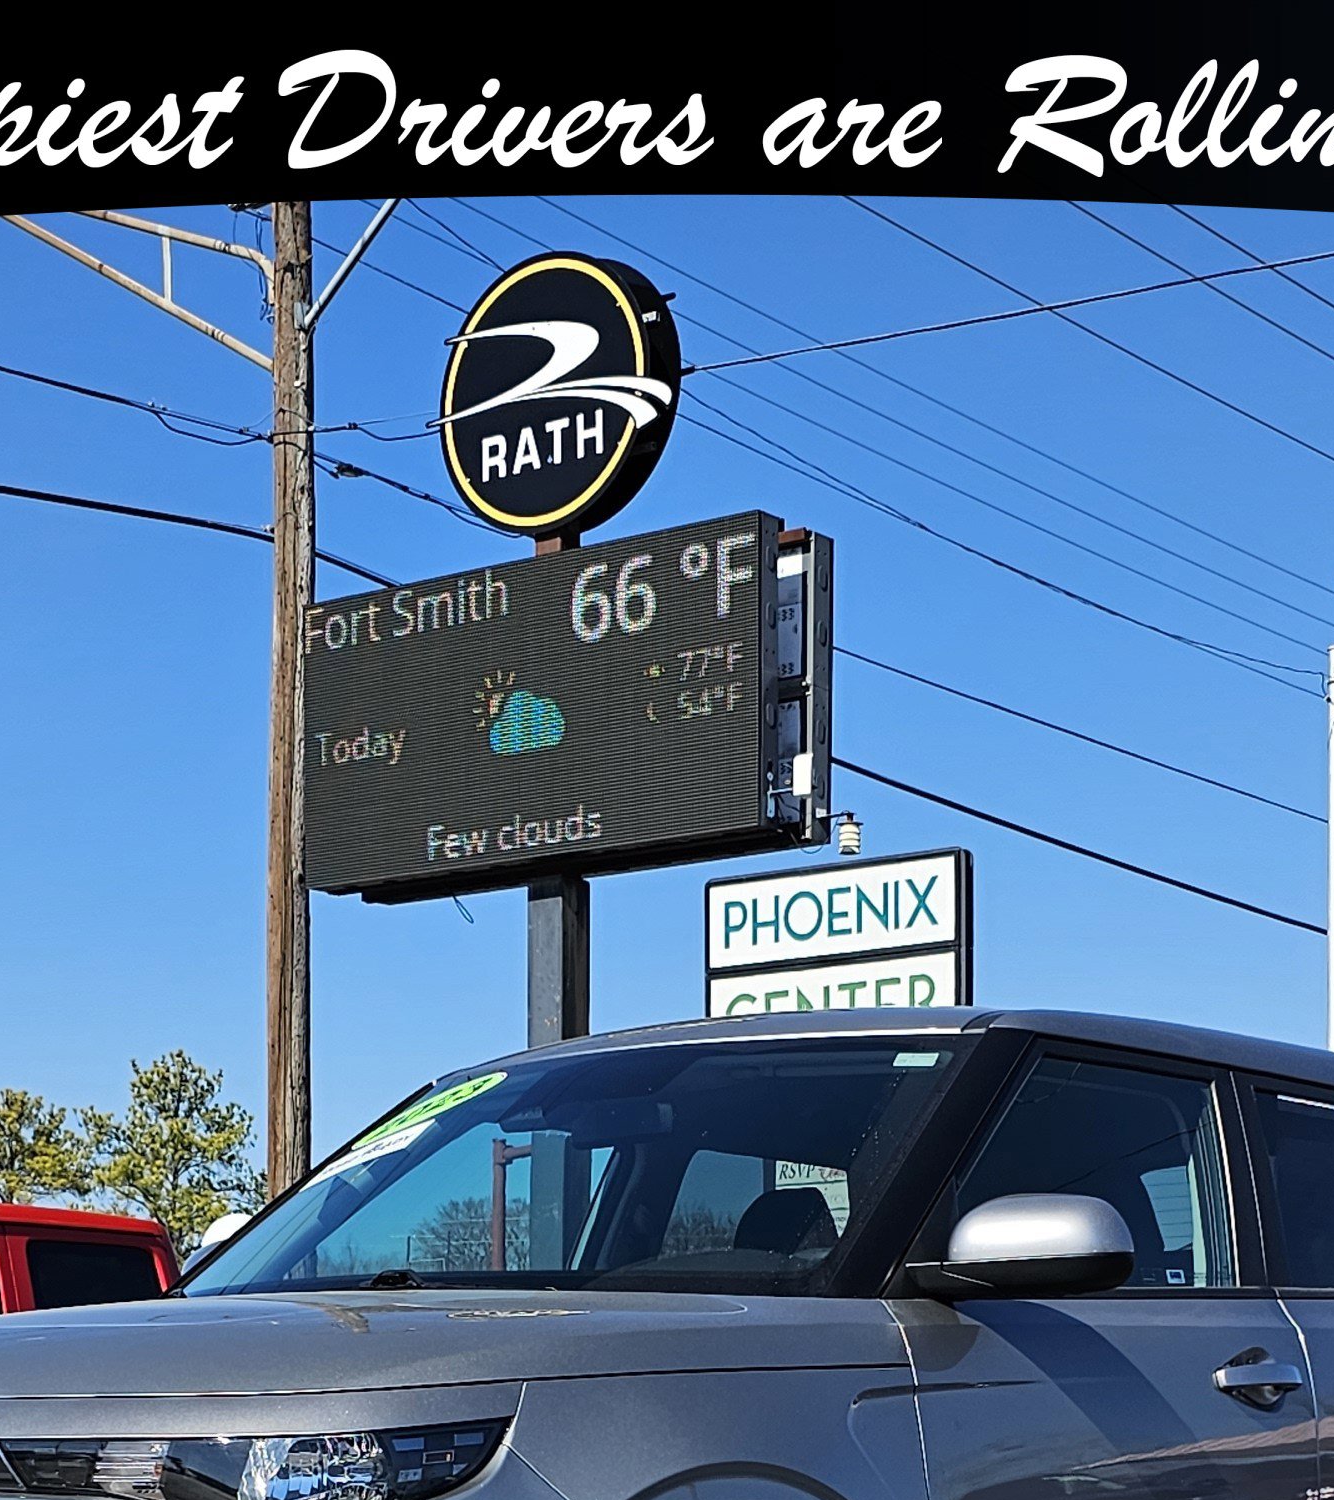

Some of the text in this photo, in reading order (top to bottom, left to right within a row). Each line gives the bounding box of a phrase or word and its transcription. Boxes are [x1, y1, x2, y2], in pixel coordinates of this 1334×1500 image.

[481, 406, 604, 483] RATH
[305, 568, 510, 655] Fort Smith
[571, 553, 657, 644] 66
[316, 727, 407, 767] Today
[426, 802, 602, 861] Few clouds
[724, 874, 939, 949] PHOENIX
[778, 1163, 815, 1180] RSVP
